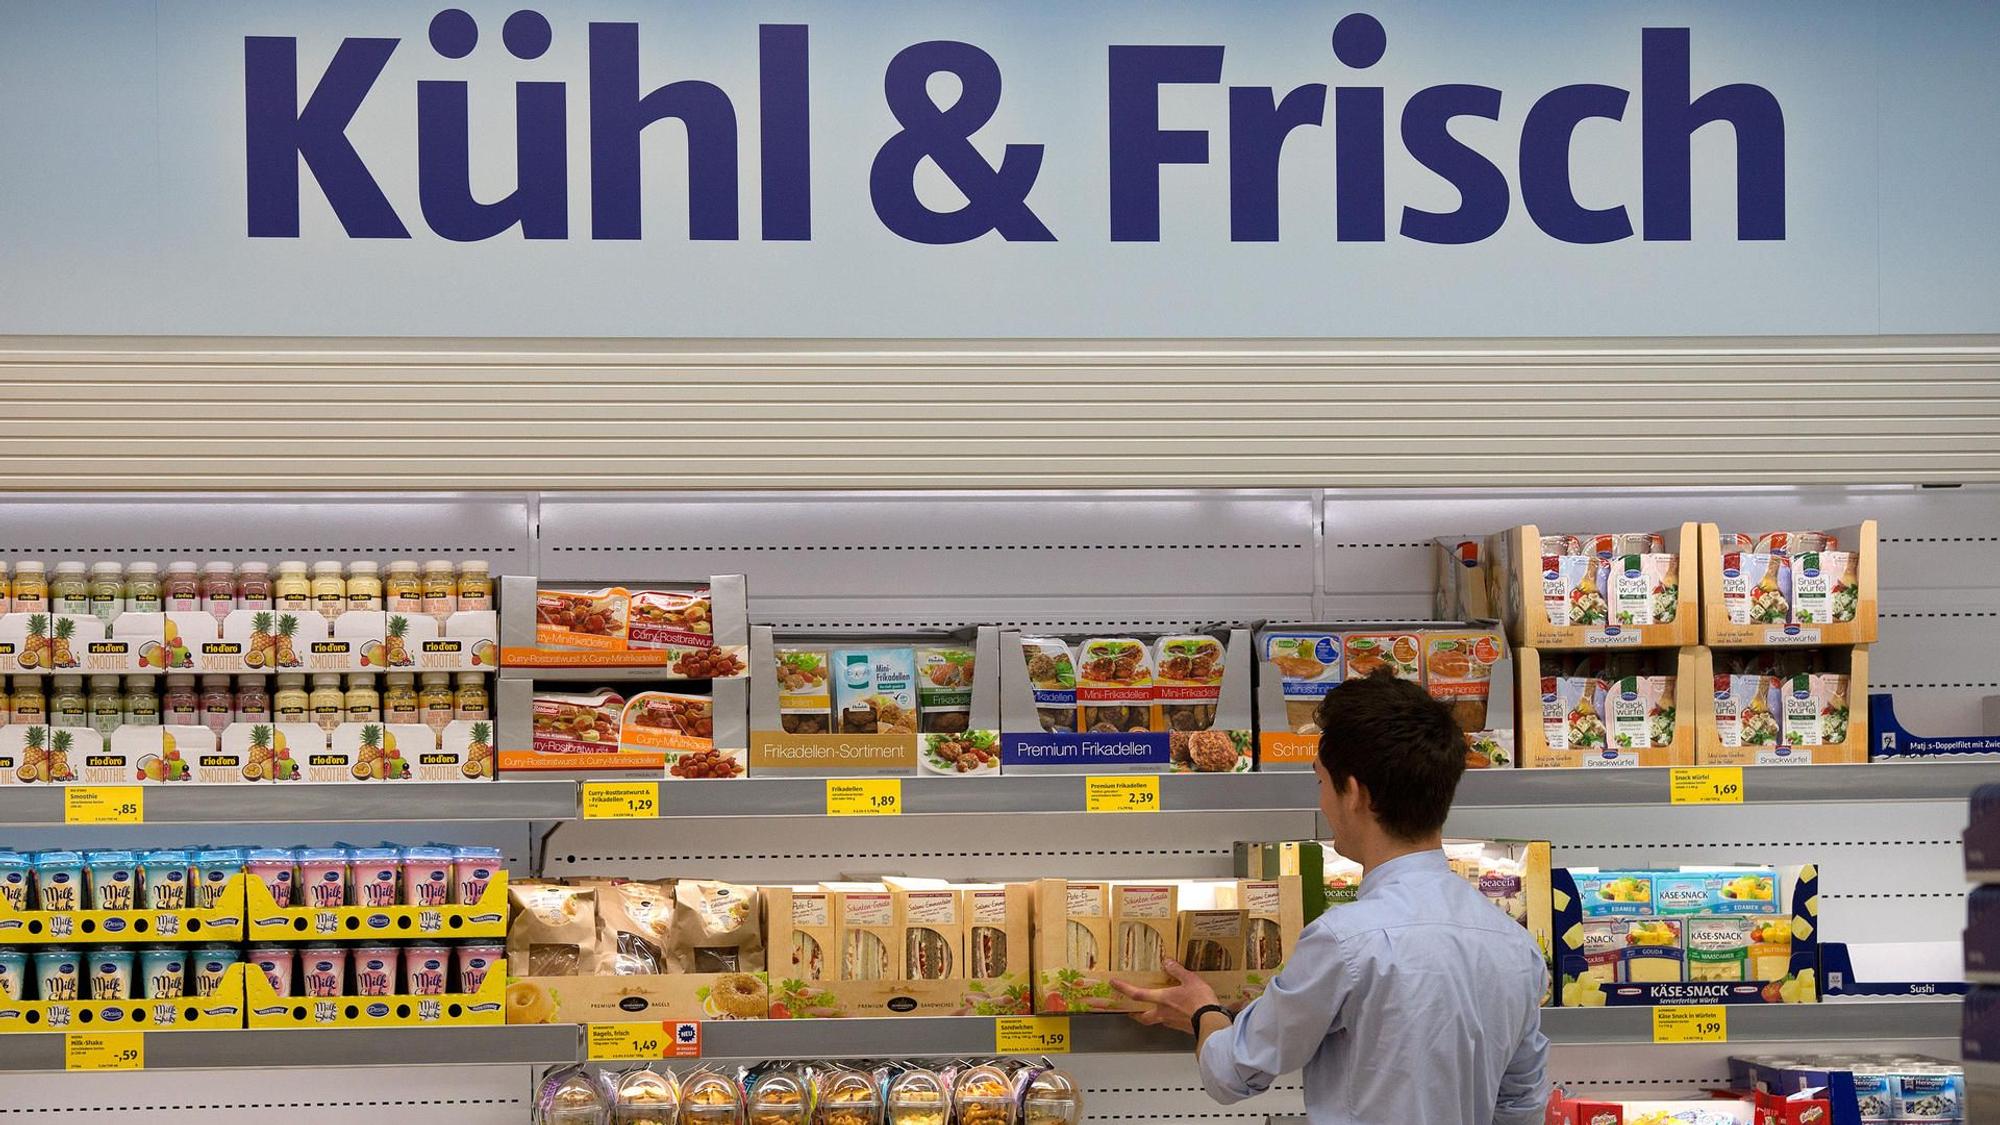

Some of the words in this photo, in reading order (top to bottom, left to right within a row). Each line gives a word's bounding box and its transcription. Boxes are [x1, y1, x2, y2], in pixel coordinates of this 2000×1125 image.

[246, 9, 811, 242] Kühl
[870, 41, 1058, 245] &
[1109, 13, 1786, 245] Frisch
[1619, 579, 1647, 587] Snack
[1797, 577, 1825, 585] Snack
[1589, 635, 1638, 643] Snackwürfel
[1768, 634, 1817, 643] Snackwürfel
[88, 655, 129, 669] SMOOTHIE
[202, 656, 242, 669] SMOOTHIE
[310, 655, 350, 669] SMOOTHIE
[421, 654, 462, 668] SMOOTHIE
[875, 664, 891, 672] Mini-
[876, 673, 911, 681] Frikadellen
[1616, 701, 1643, 709] Snack
[763, 743, 905, 759] Frikadellen-Sortiment
[1017, 742, 1078, 757] Premium
[1082, 741, 1152, 756] Frikadellen
[1587, 759, 1635, 767] Snackwürfel
[1760, 756, 1808, 764] Snackwürfel
[85, 768, 127, 783] SMOOTHIE
[199, 768, 240, 783] SMOOTHIE
[309, 767, 349, 782] SMOOTHIE
[419, 766, 460, 781] SMOOTHIE
[1713, 784, 1737, 796] 1,69
[871, 795, 895, 807] 1,89
[1129, 793, 1154, 804] 2,39
[628, 800, 653, 811] 1,29
[43, 887, 75, 902] Milk
[100, 885, 130, 900] Milk
[154, 884, 184, 901] Milk
[311, 884, 341, 900] Milk
[364, 884, 394, 899] Milk
[416, 884, 445, 899] Milk
[1660, 890, 1709, 900] KÄSE-SNACK
[50, 916, 73, 926] Milk
[156, 915, 179, 925] Milk
[315, 913, 337, 924] Milk
[419, 912, 441, 921] Milk
[1584, 935, 1614, 943] -SNACK
[1691, 931, 1742, 941] KÄSE-SNACK
[45, 977, 76, 992] Milk
[92, 977, 122, 992] Milk
[153, 975, 182, 991] Milk
[306, 974, 336, 991] Milk
[358, 973, 387, 989] Milk
[413, 972, 442, 988] Milk
[1650, 984, 1729, 997] KÄSE-SNACK
[1910, 984, 1935, 993] Sushi
[47, 1006, 70, 1016] Milk
[154, 1004, 176, 1015] Milk
[315, 1002, 337, 1012] Milk
[418, 1000, 440, 1010] Milk
[1696, 1023, 1721, 1034] 1,99
[1041, 1034, 1064, 1045] 1,59
[632, 1040, 657, 1052] 1,49
